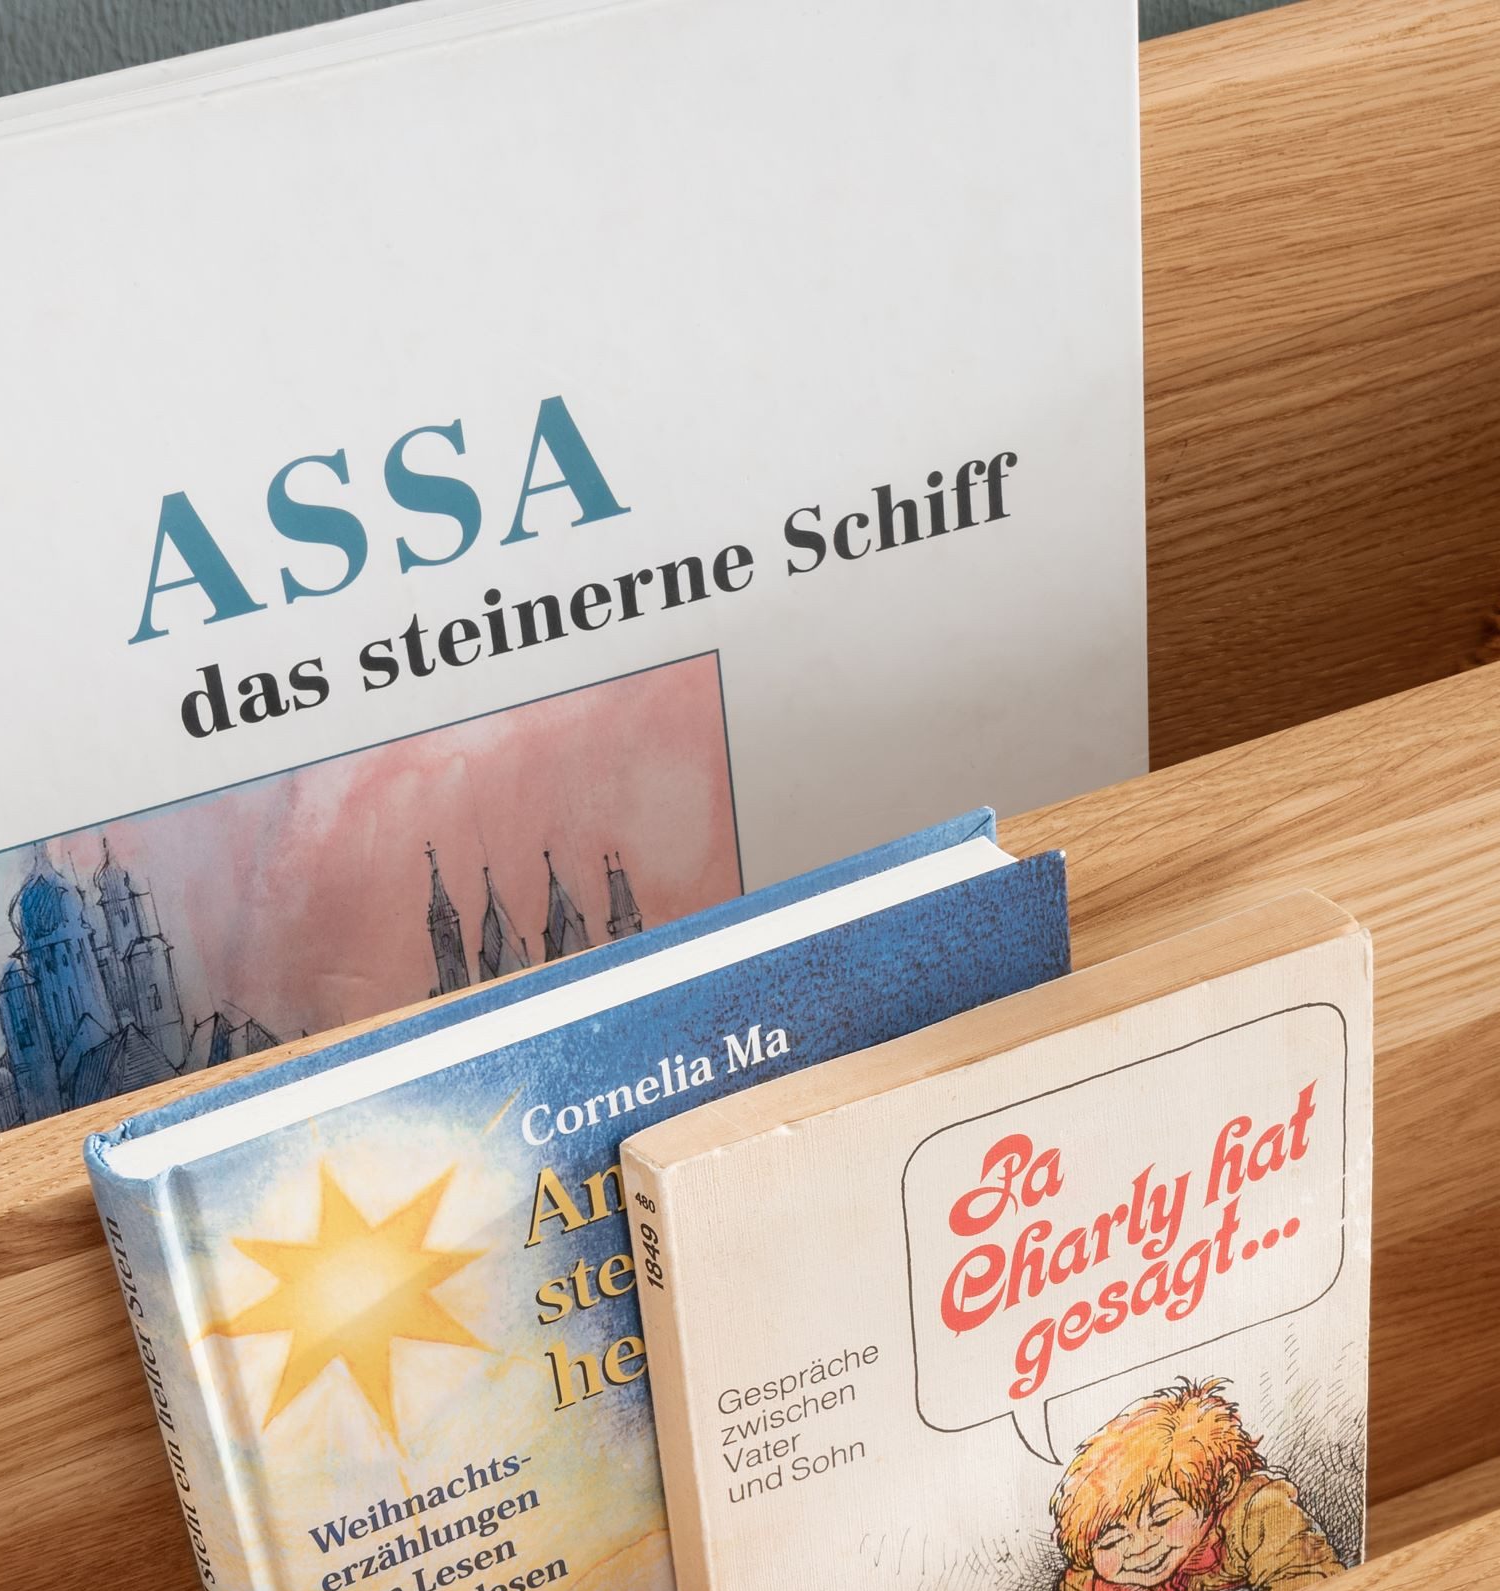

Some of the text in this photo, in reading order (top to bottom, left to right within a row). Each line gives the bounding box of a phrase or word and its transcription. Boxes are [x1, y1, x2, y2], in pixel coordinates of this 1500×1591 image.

[127, 394, 632, 646] ASSA
[180, 451, 1018, 739] das steinerne Schiff
[521, 1022, 791, 1147] Cornelia Ma
[634, 1191, 656, 1214] 480
[940, 1078, 1318, 1338] Charly hat
[948, 1133, 1065, 1238] Pa
[105, 1215, 145, 1319] Stern
[535, 1250, 637, 1326] ste
[641, 1222, 665, 1291] 1849
[1008, 1193, 1301, 1401] gesagt...
[135, 1325, 176, 1433] heller
[717, 1344, 880, 1415] Gespräche
[720, 1383, 856, 1447] zwischen
[166, 1438, 190, 1492] ein
[723, 1432, 802, 1473] Vater
[728, 1440, 866, 1504] und Sohn
[182, 1498, 216, 1586] steht
[307, 1453, 532, 1555] Weihnachts-
